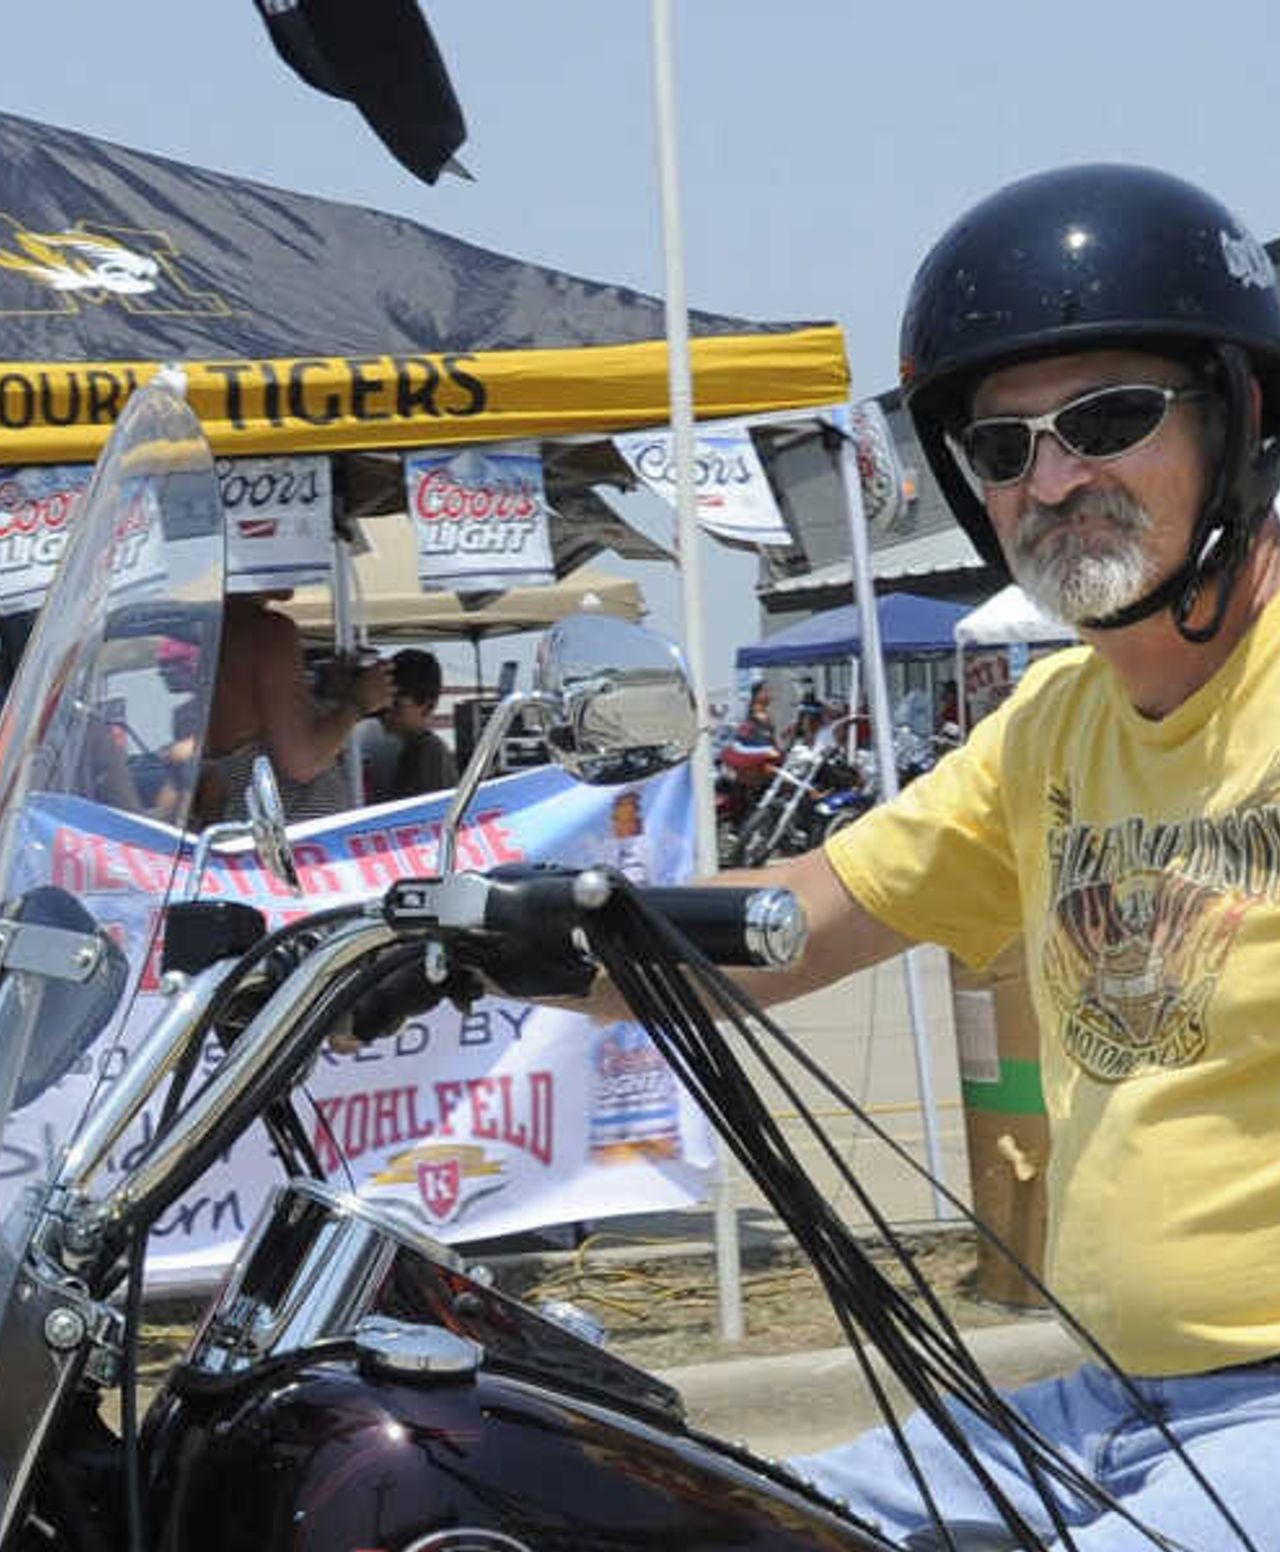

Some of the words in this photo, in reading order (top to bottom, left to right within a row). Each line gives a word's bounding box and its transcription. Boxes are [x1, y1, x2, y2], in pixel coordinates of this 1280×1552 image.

[204, 354, 489, 431] TIGERS
[218, 462, 319, 509] oors
[414, 468, 537, 522] Coors
[418, 520, 535, 557] LIGHT
[458, 1004, 533, 1047] BY
[313, 1069, 554, 1174] KOHLFELD
